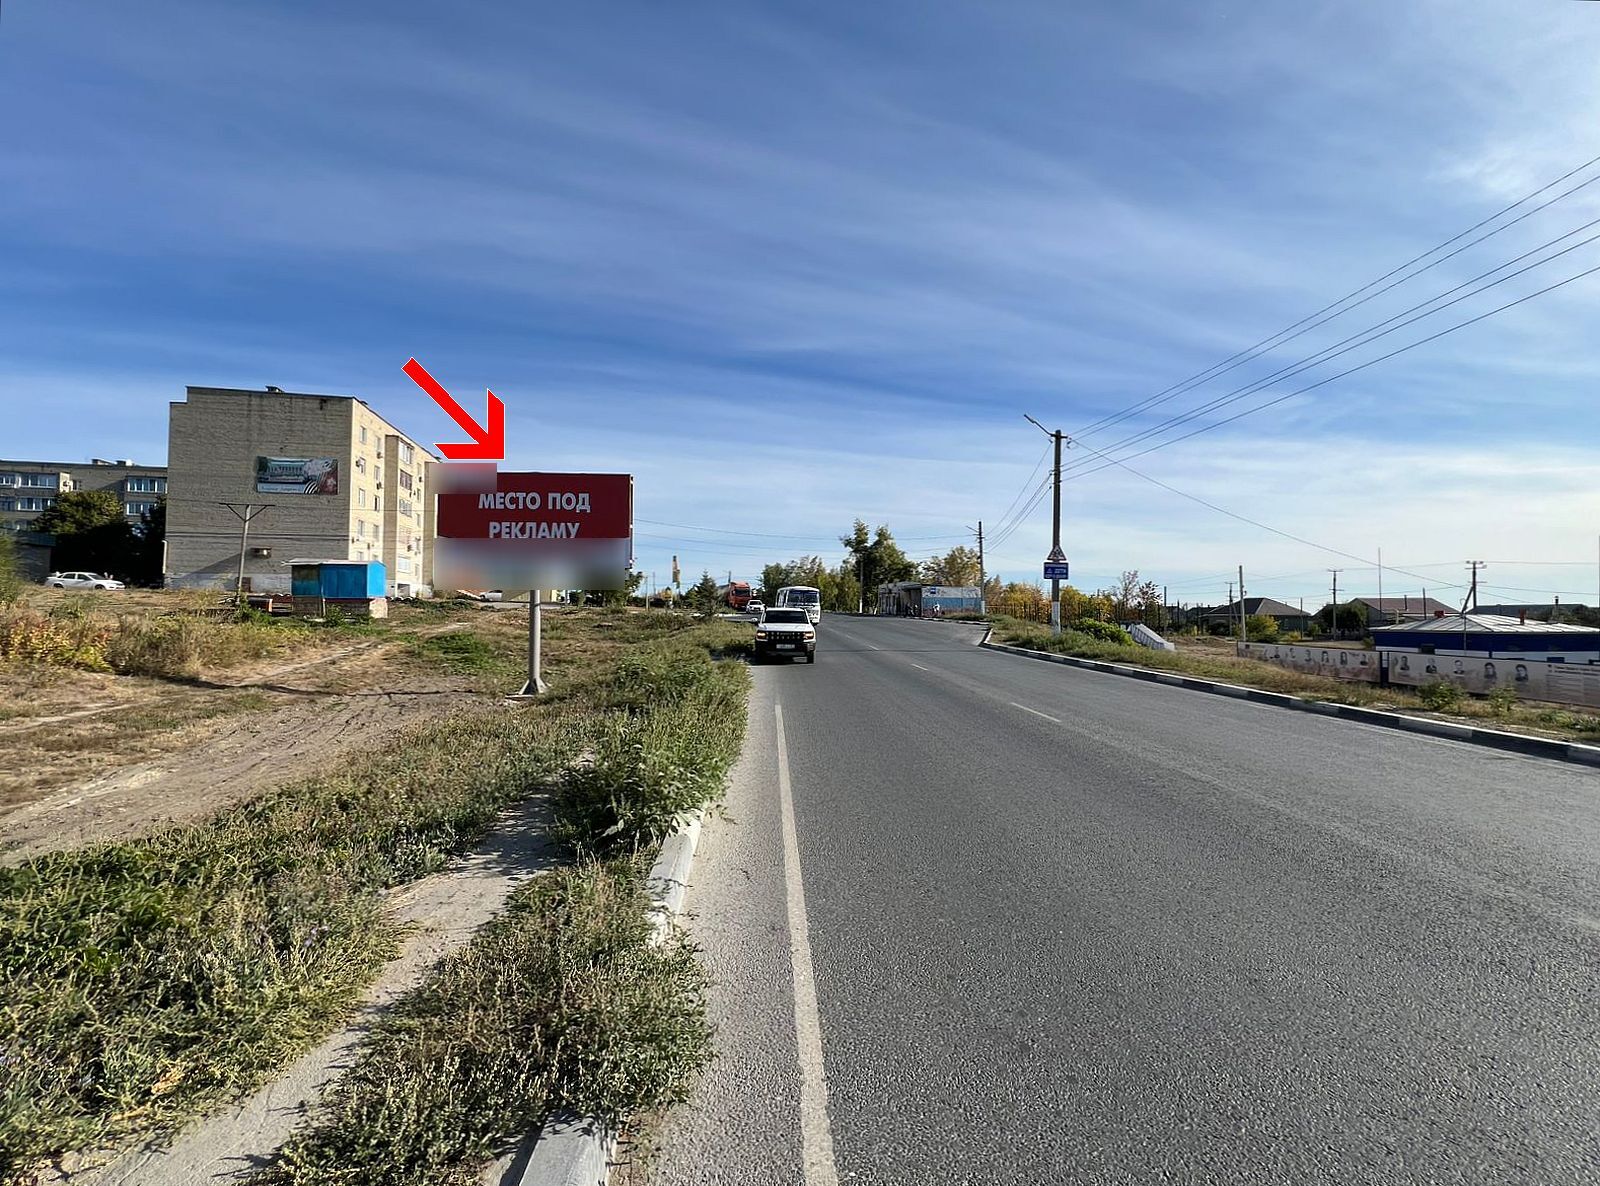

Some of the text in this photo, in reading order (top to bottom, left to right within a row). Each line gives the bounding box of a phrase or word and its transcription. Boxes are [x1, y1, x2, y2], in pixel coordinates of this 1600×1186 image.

[479, 492, 591, 513] МЕСТО ПОД
[489, 523, 580, 539] РЕКЛАМУ
